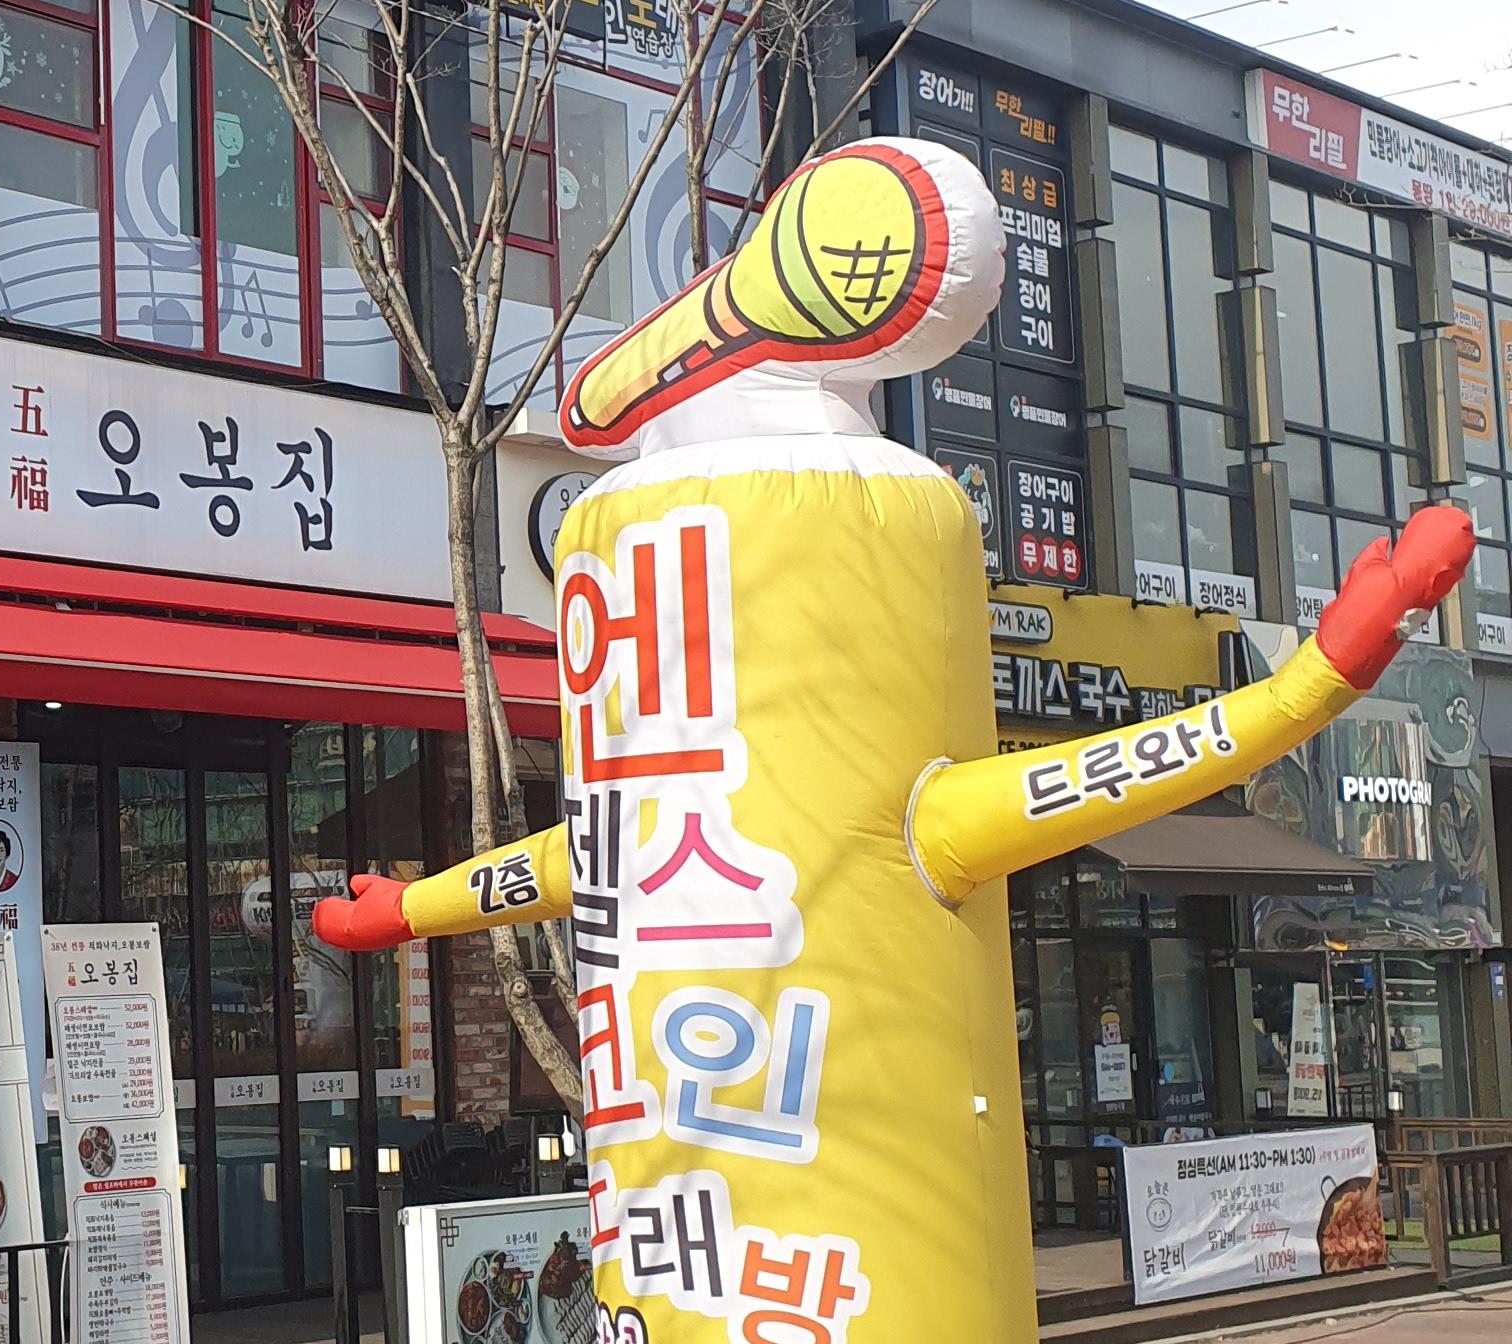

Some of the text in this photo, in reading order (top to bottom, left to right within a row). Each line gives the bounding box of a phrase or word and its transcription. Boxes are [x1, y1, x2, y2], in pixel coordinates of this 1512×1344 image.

[1270, 86, 1312, 131] 무한
[1307, 127, 1346, 171] 리필
[999, 205, 1062, 250] 프리미엄
[1018, 278, 1051, 314] 장어
[1021, 314, 1054, 351] 구이
[9, 383, 52, 514] 五福
[75, 408, 336, 553] 오봉집
[1018, 470, 1075, 507] 장어구이
[1020, 503, 1077, 537] 공기밥
[1022, 541, 1078, 574] 무제한
[1135, 572, 1177, 599] 어구이
[1199, 580, 1248, 610] 장어정식
[1015, 612, 1046, 634] RAK
[1079, 664, 1131, 725] 국수
[1029, 705, 1231, 816] 드루와!
[470, 853, 540, 914] 2층
[80, 957, 139, 987] 오봉집
[1143, 1242, 1187, 1279] 닭갈비
